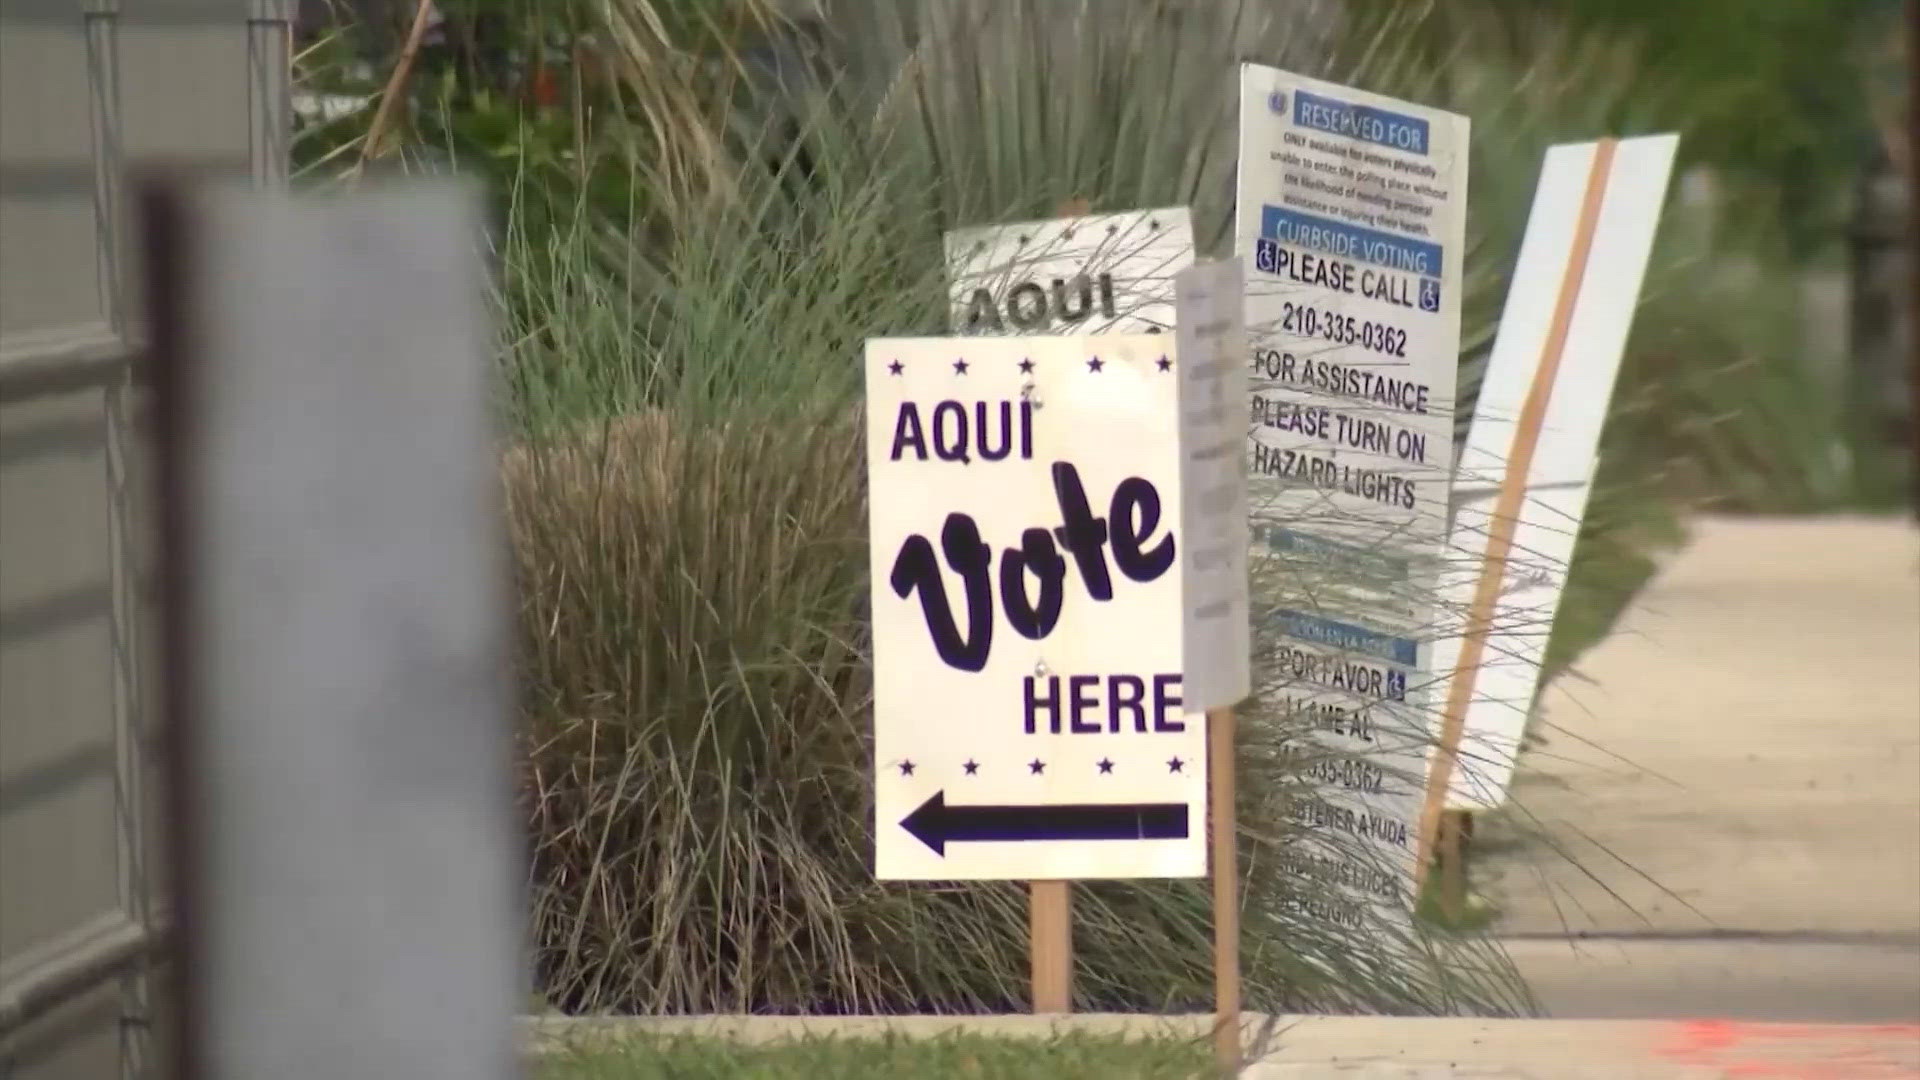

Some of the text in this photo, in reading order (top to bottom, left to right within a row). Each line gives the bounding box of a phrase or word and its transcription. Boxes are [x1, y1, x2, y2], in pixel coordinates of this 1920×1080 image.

[1301, 102, 1384, 141] RESERVED
[1388, 123, 1422, 151] FOR
[1269, 151, 1448, 200] unable to enter the polling place without
[1284, 132, 1307, 147] ONLY
[1309, 138, 1348, 155] available
[1364, 153, 1393, 169] voters
[1393, 157, 1437, 179] physically
[1284, 173, 1433, 217] the likelihood of needing personal
[1284, 194, 1430, 237] assistance or injuring their health.
[1277, 218, 1428, 273] CURBSIDE VOTING
[966, 272, 1116, 331] AQUI
[1277, 248, 1414, 308] PLEASE CALL
[1283, 302, 1408, 358] 210-335-0362
[1255, 349, 1296, 383] FOR
[1301, 359, 1430, 414] ASSISTANCE
[890, 399, 1033, 466] AQUI
[1252, 395, 1426, 463] PLEASE TURN ON
[1255, 445, 1338, 489] HAZARD
[1344, 466, 1416, 510] LIGHTS
[890, 460, 1176, 673] Vote
[1279, 647, 1383, 699] POR FAVOR
[1023, 673, 1186, 735] HERE
[1350, 711, 1373, 743] AL
[1278, 740, 1383, 794] 335-0362
[1357, 813, 1408, 846] AYUDA
